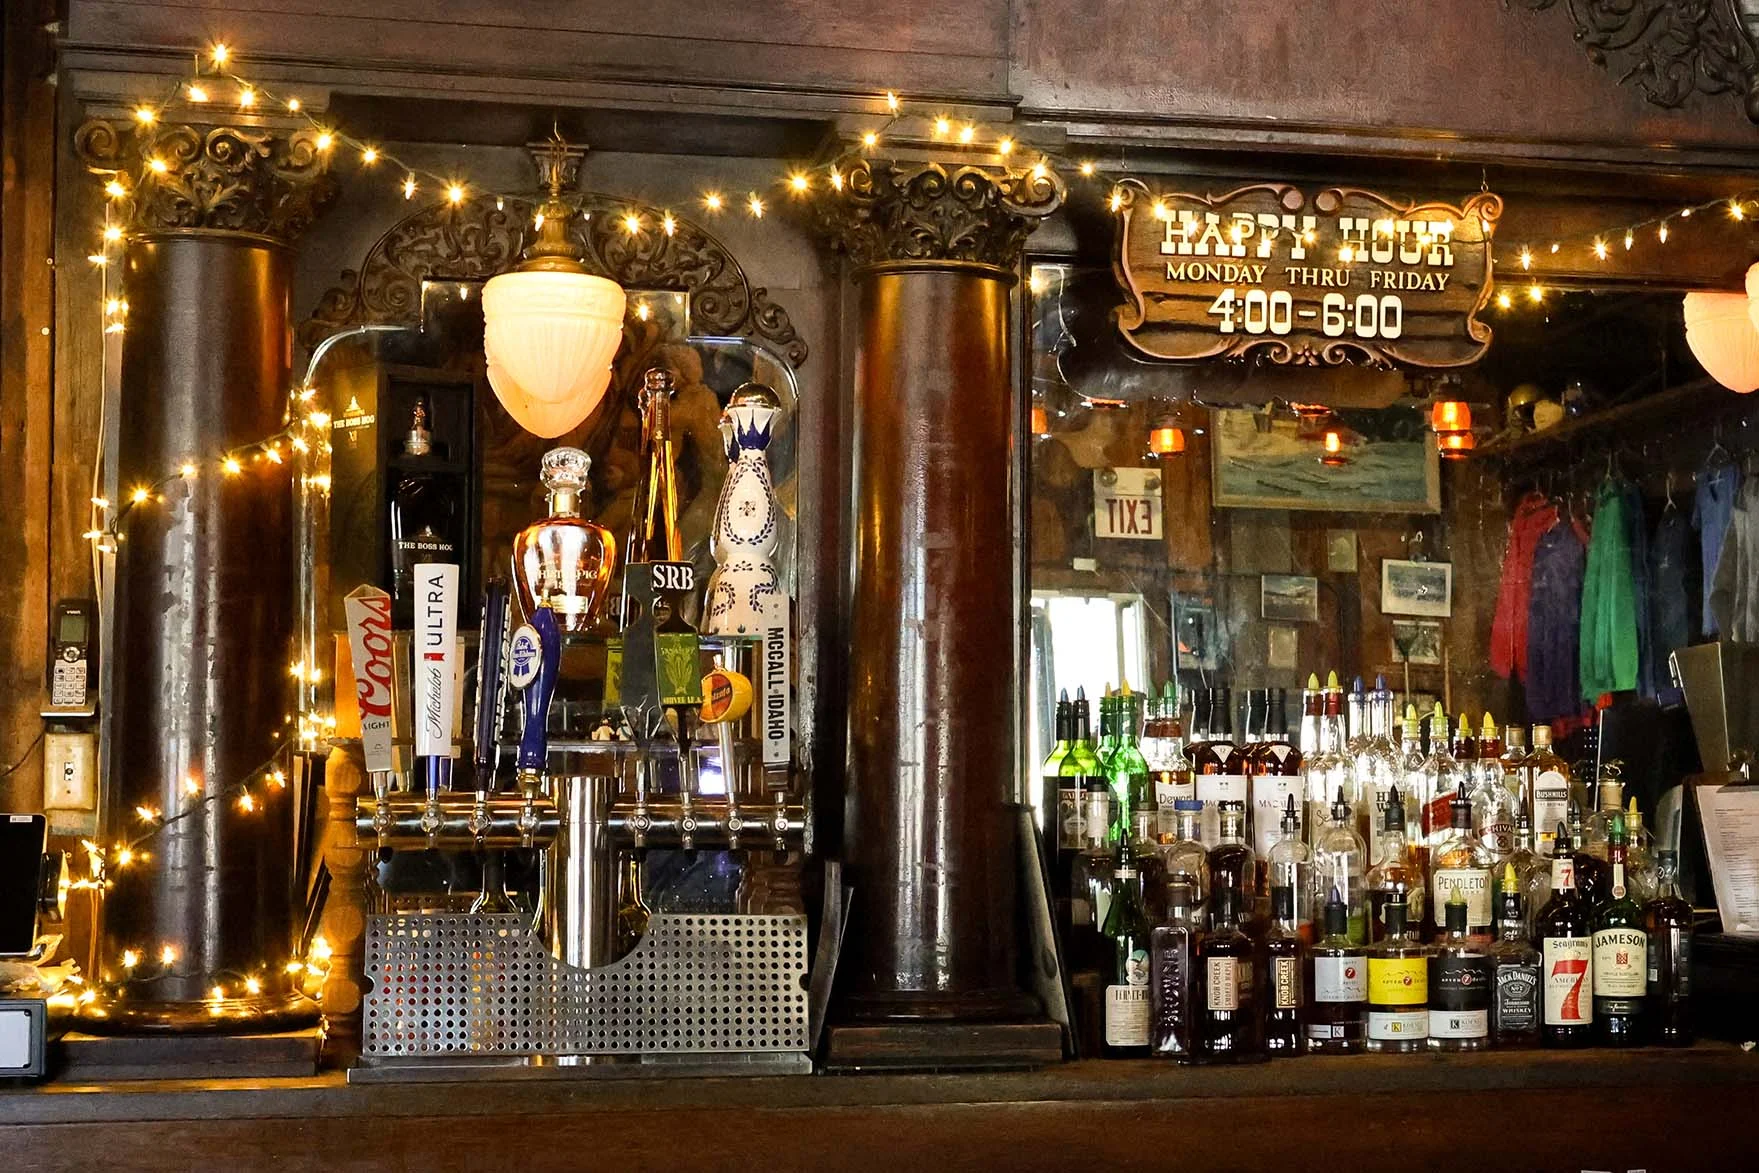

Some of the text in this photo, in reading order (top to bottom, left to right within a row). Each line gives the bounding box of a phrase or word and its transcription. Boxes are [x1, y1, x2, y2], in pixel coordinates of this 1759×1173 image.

[1160, 210, 1454, 266] HAPPY HOUR
[1166, 262, 1450, 292] MONDAY THRU FRIDAY
[398, 541, 416, 550] THE
[417, 542, 438, 550] BOSS
[653, 564, 694, 590] SRB
[356, 597, 392, 720] Coors
[426, 575, 445, 740] Michelob ULTRA
[768, 627, 784, 740] MCCALL IDAHO
[363, 721, 390, 730] LIGHT
[1596, 934, 1645, 948] JAMESON
[1213, 961, 1221, 985] CREEK
[1281, 960, 1289, 1005] KNOB CREEK
[1551, 959, 1589, 1020] 7
